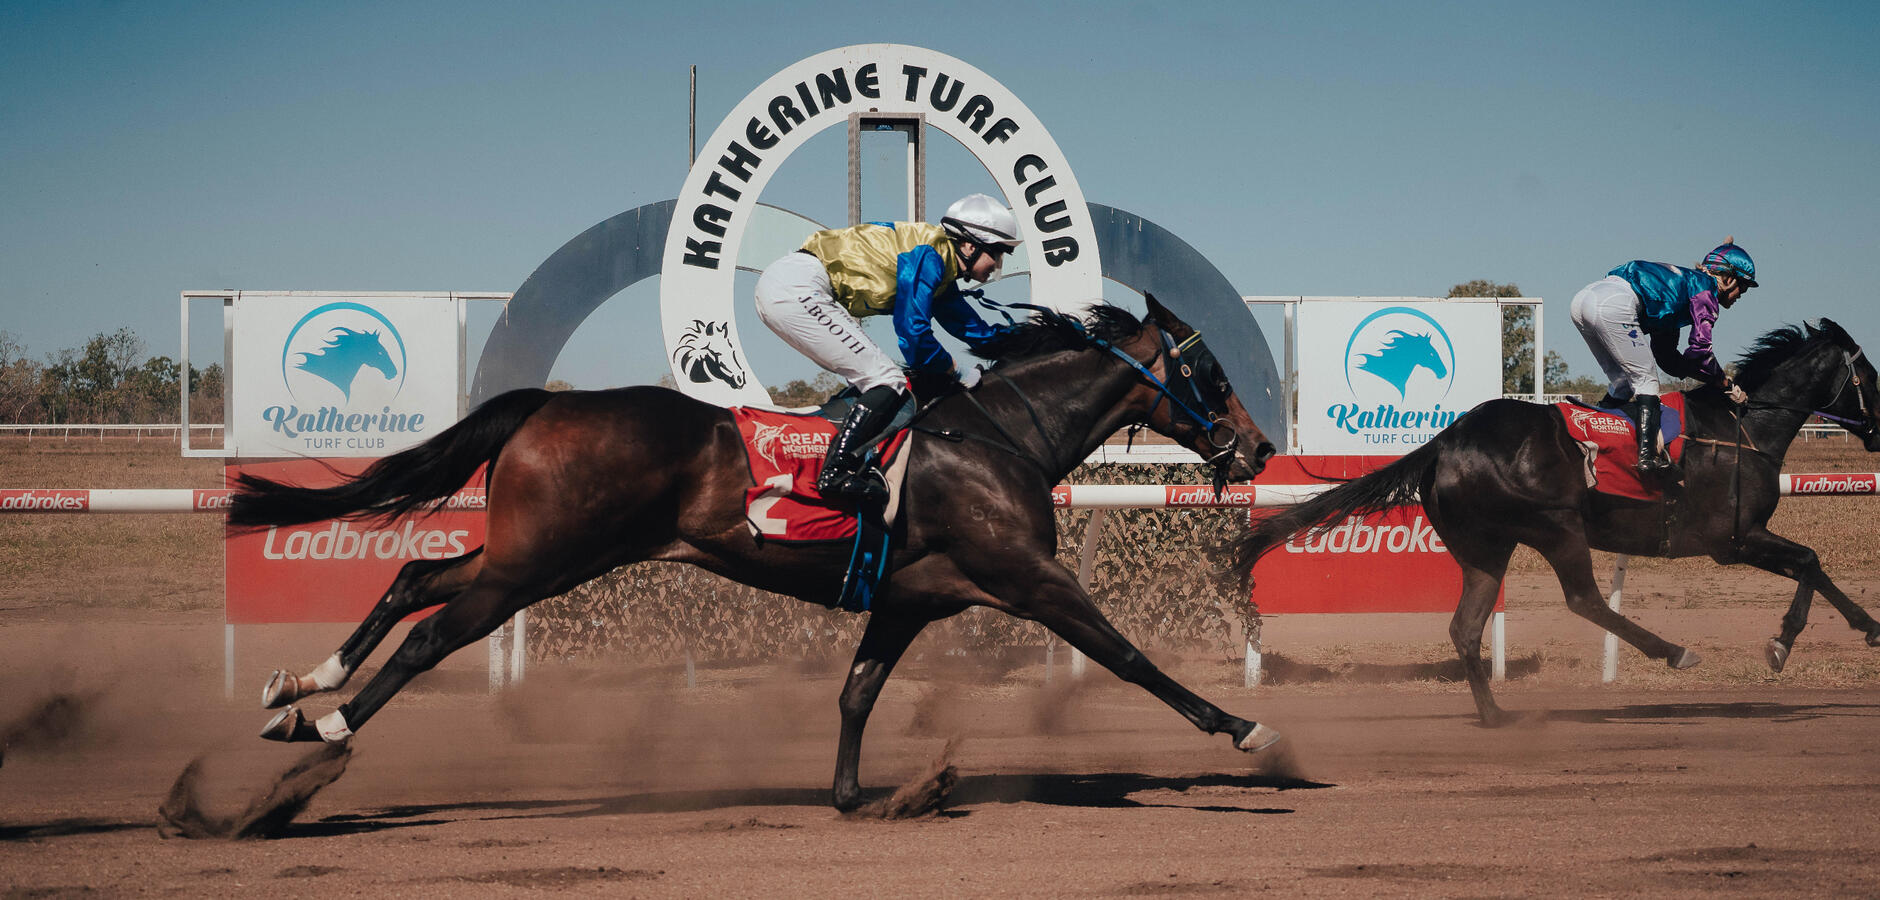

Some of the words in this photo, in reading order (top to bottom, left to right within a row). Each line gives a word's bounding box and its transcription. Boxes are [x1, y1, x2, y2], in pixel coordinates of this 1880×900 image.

[683, 63, 880, 270] KATHERINE
[902, 64, 1020, 145] TURF
[1013, 153, 1079, 268] CLUB
[798, 296, 866, 354] J.BOOTH
[263, 405, 425, 439] Katherine
[1589, 417, 1627, 427] GREAT
[304, 438, 342, 449] TURF
[346, 438, 385, 449] CLUB
[1364, 433, 1397, 444] TURF
[1795, 477, 1873, 493] Ladbrokes
[0, 492, 85, 510] adbrokes
[263, 520, 469, 560] Ladbrokes
[1285, 515, 1449, 554] Ladbroke
